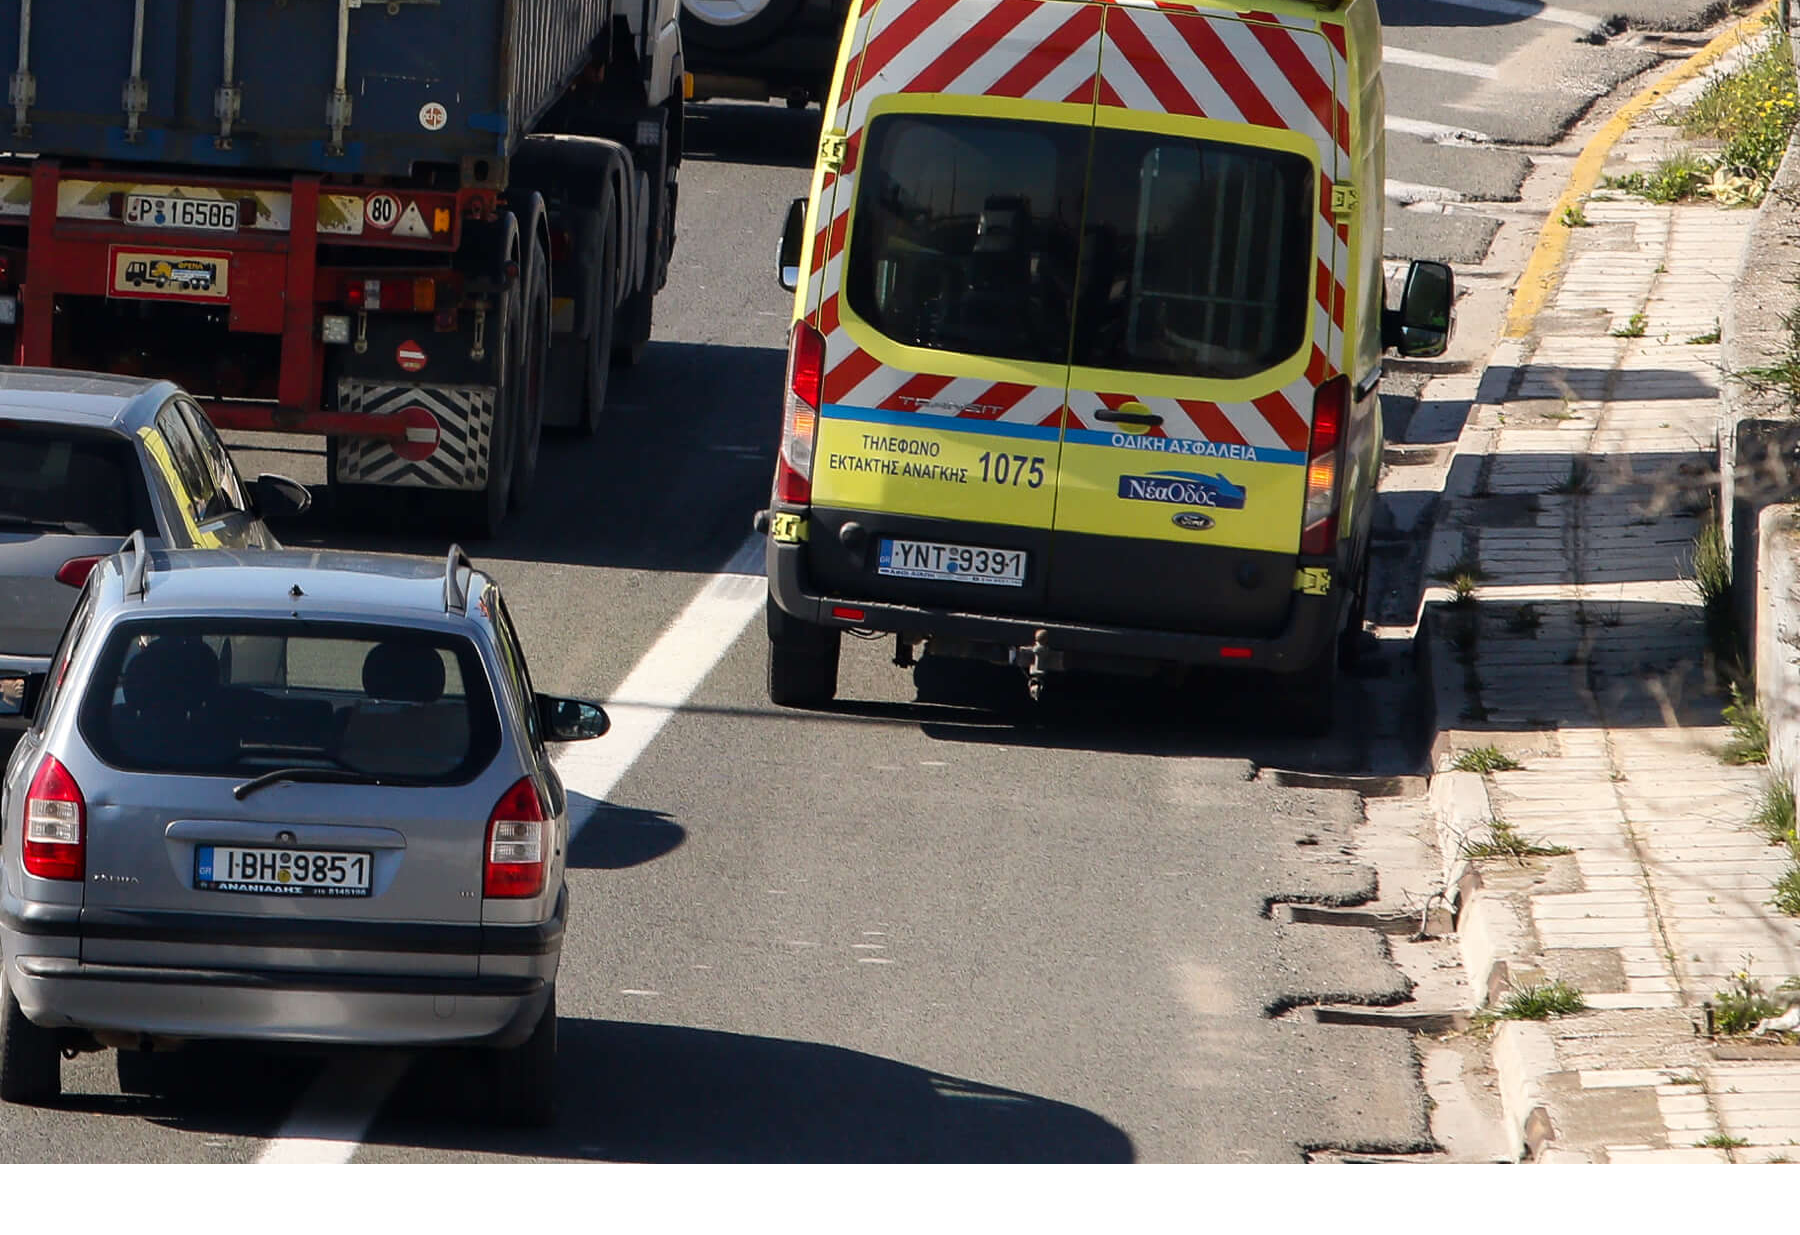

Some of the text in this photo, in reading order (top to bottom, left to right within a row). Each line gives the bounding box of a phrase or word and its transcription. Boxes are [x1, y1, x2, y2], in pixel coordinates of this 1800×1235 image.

[372, 197, 391, 222] 80
[862, 434, 940, 457] ΤΗΛΕΦΩΝΟ
[1111, 433, 1257, 461] ΟΔΙΚΗ ΑΣΦΑΛΕΙΑ
[829, 454, 968, 484] ΕΚΤΑΚΤΗΣ ΑΝΑΓΚΗΣ
[978, 451, 1045, 489] 1075
